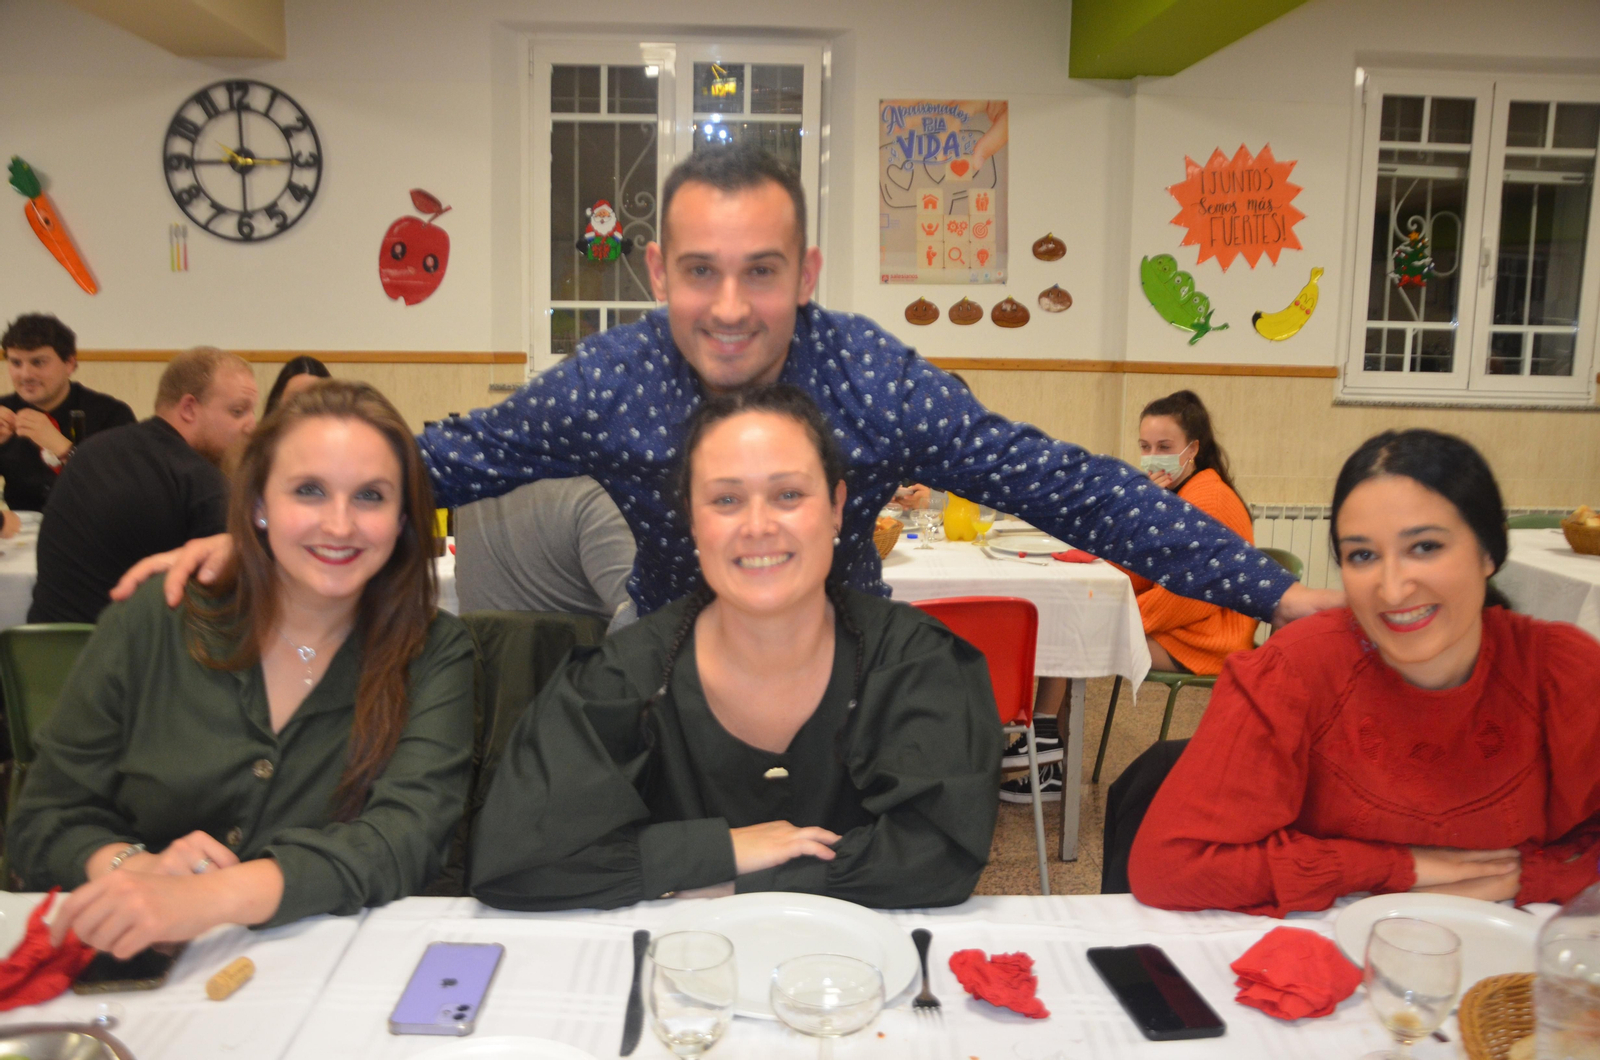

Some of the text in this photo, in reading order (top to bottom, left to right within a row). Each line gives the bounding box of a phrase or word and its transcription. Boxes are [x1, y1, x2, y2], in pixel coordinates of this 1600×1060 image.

[195, 90, 220, 119] 11
[225, 81, 250, 111] 12
[264, 90, 278, 116] 1
[171, 116, 200, 143] 10
[282, 115, 308, 139] 2
[896, 129, 961, 160] VIDA
[166, 153, 193, 171] 9
[293, 151, 318, 168] 3
[176, 185, 200, 205] 8
[287, 179, 314, 203] 4
[204, 201, 227, 227] 7
[237, 212, 255, 240] 6
[264, 201, 288, 230] 5
[1210, 213, 1287, 247] FUERTES!
